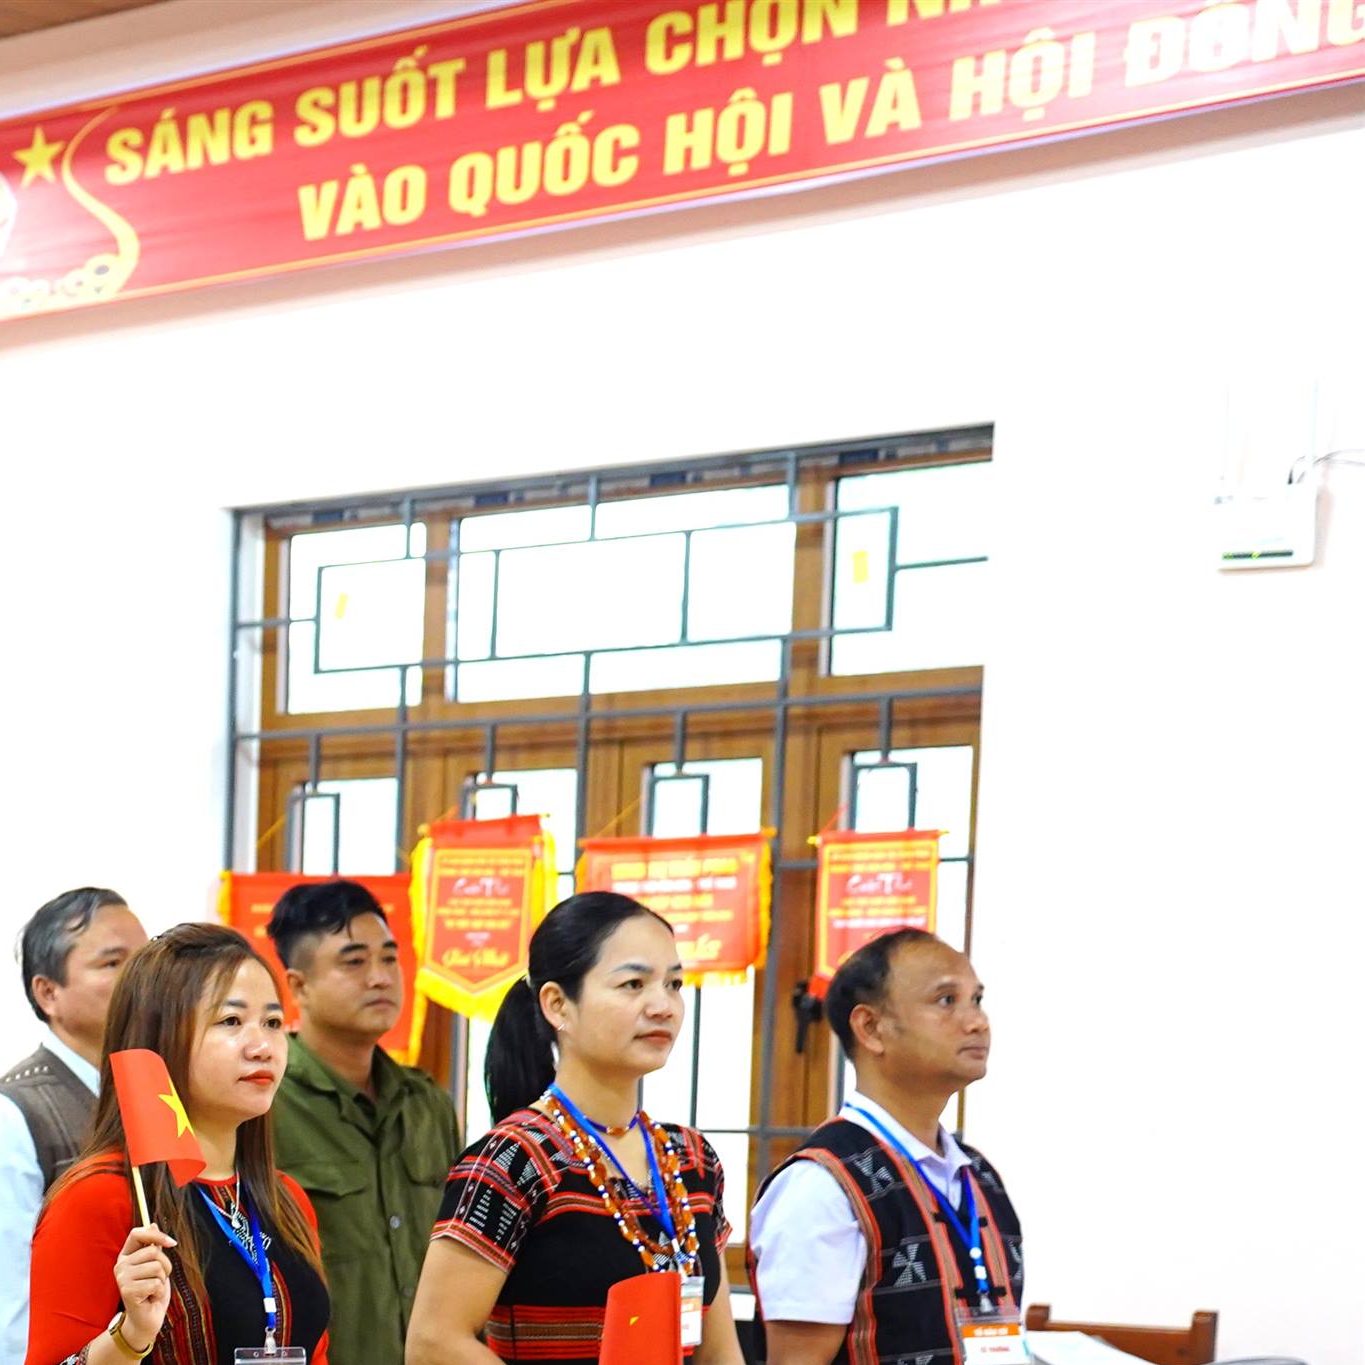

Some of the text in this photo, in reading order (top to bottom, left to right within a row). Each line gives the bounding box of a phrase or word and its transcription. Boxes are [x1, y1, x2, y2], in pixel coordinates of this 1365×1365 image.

[105, 0, 858, 185] SÁNG SUỐT LỰA CHỌN
[298, 163, 427, 241] VÀO
[449, 110, 640, 217] QUỐC
[663, 87, 793, 177] HỘI
[819, 57, 922, 145] VÀ
[949, 27, 1096, 121] HỘI
